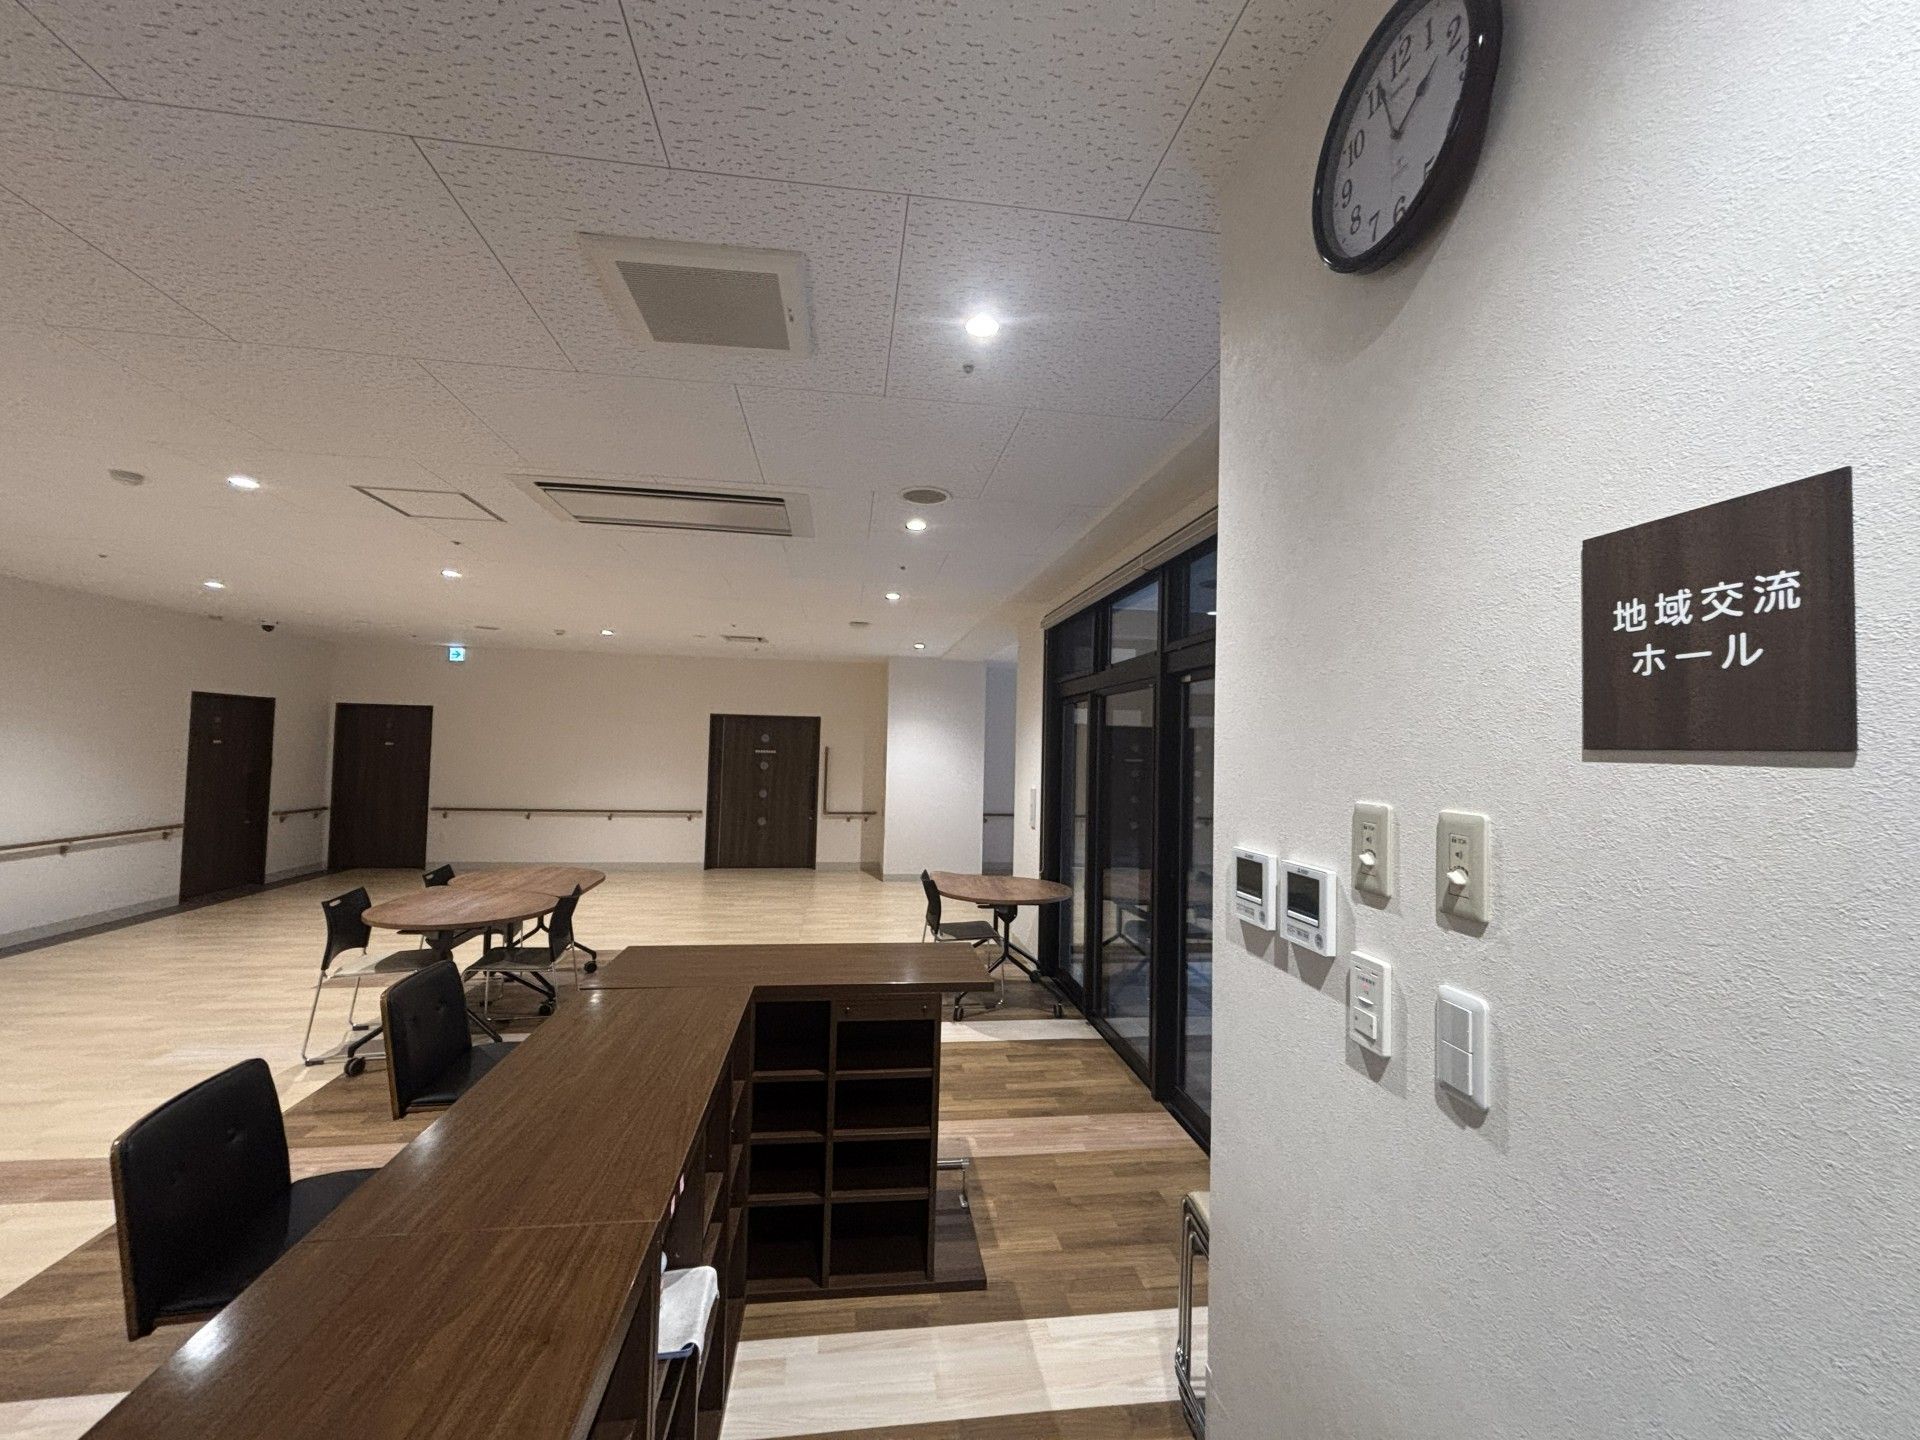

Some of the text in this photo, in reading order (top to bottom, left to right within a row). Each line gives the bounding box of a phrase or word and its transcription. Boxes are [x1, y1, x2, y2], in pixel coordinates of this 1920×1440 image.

[1425, 17, 1434, 52] 1
[1391, 34, 1411, 82] 12
[1368, 82, 1382, 119] 11
[1347, 130, 1364, 168] 10
[1342, 179, 1352, 209] 9
[1350, 204, 1361, 235] 8
[1369, 209, 1380, 242] 7
[1613, 570, 1801, 632] 地域交流
[1632, 632, 1763, 676] ホール
